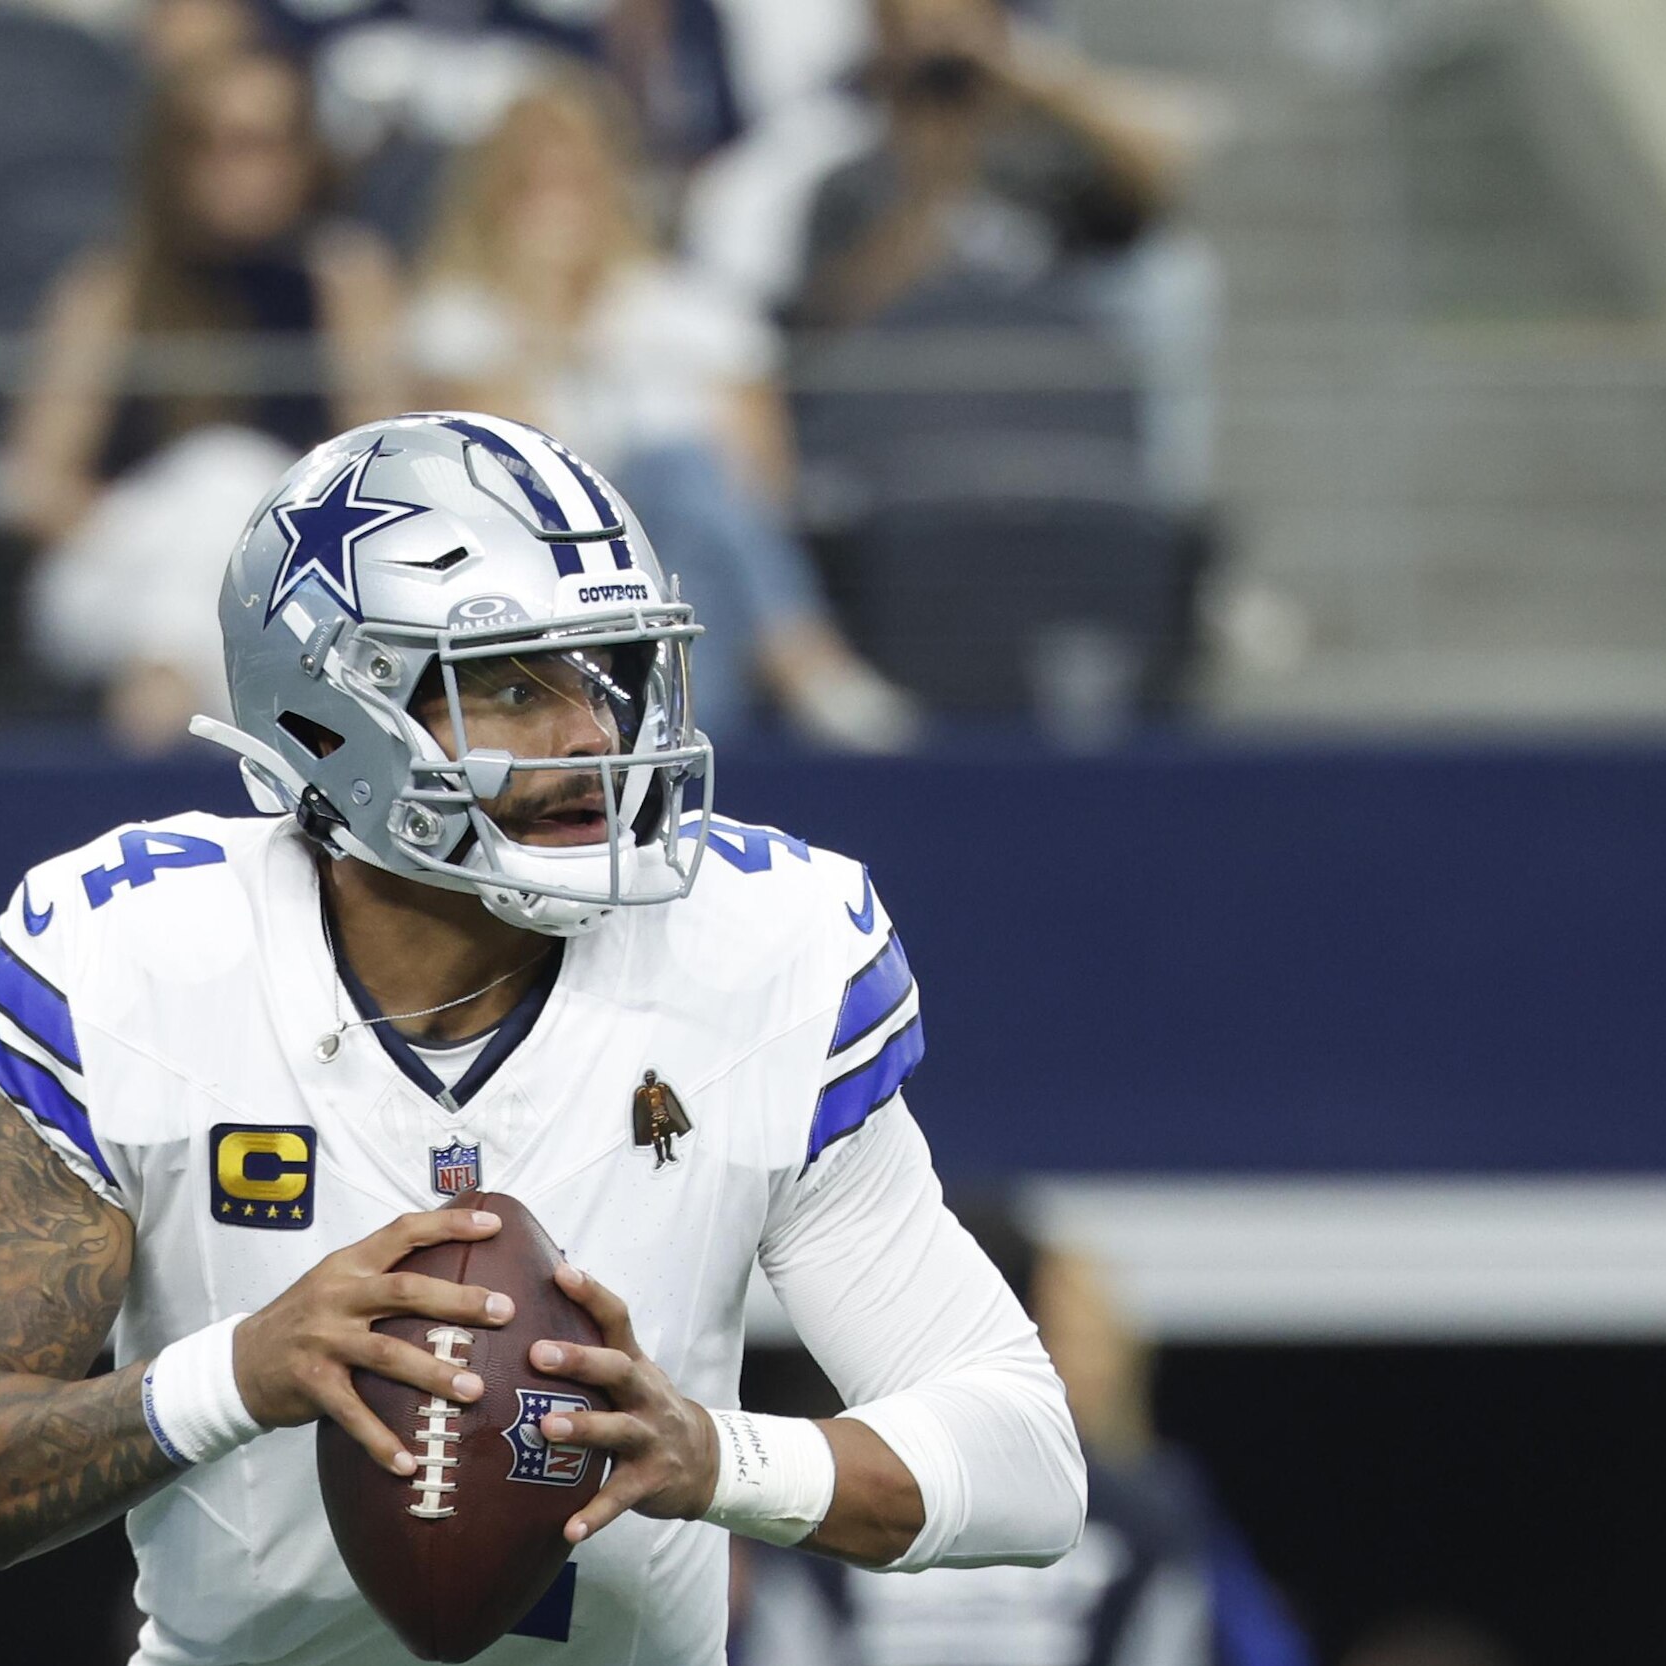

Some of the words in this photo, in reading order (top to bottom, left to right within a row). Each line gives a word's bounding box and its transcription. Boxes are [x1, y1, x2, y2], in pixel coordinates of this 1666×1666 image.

[578, 585, 648, 603] COWBOYS
[450, 613, 520, 631] OAKLEY
[81, 830, 226, 910] 4
[678, 819, 811, 874] 4
[217, 1131, 308, 1201] C
[439, 1166, 476, 1191] NFL
[737, 1414, 770, 1468] THANK
